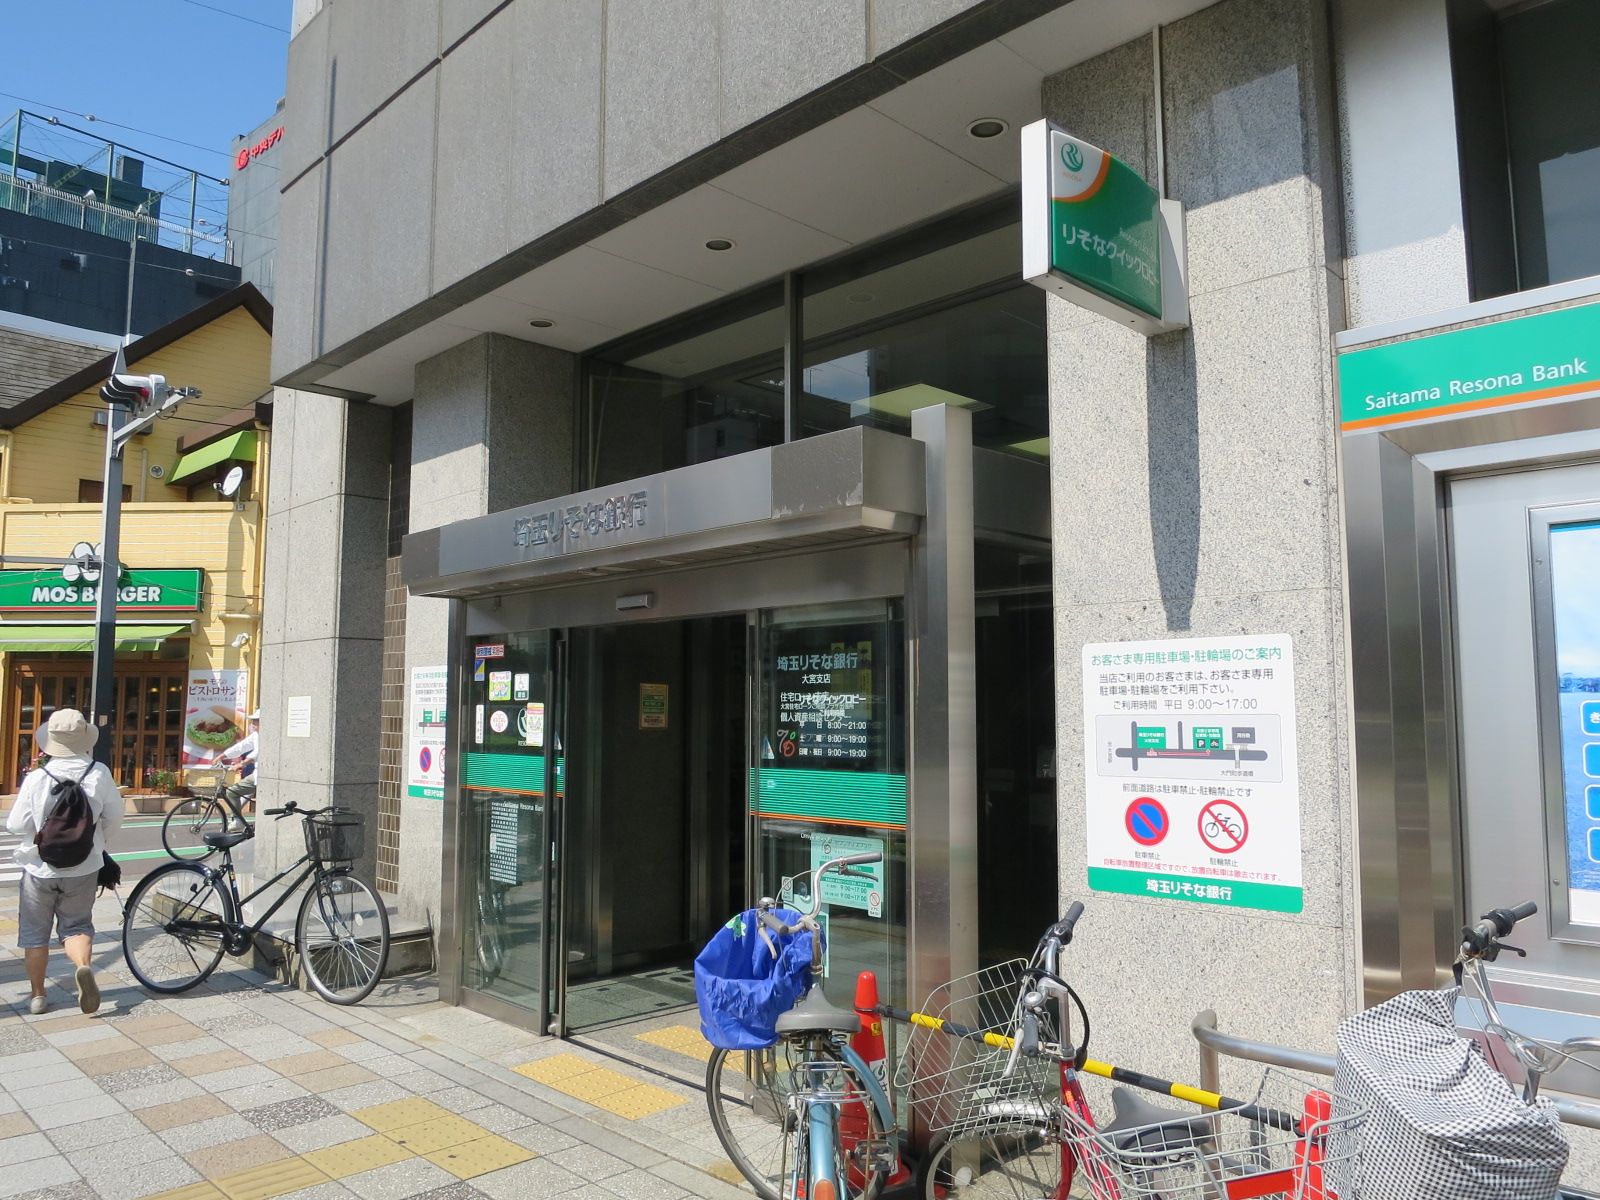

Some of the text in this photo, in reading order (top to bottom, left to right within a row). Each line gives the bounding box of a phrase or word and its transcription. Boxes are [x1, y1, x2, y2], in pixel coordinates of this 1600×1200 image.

[1365, 357, 1588, 411] Saitama Resona Bank
[513, 490, 648, 547] 埼玉りそな銀行
[31, 586, 78, 603] MOS
[776, 652, 858, 671] 埼玉りそな銀行
[1091, 646, 1281, 665] お客さま専用駐車場・駐輪場のご案内
[801, 674, 831, 684] 大宮支店
[1099, 668, 1274, 683] 当店ご利用のお客さまは、お客さま専用
[1099, 683, 1234, 696] 駐車場・駐輪場をご利用下さい。
[1113, 699, 1158, 710] ご利用時間
[1164, 699, 1183, 710] 平日
[1146, 878, 1233, 901] 埼玉りそな銀行
